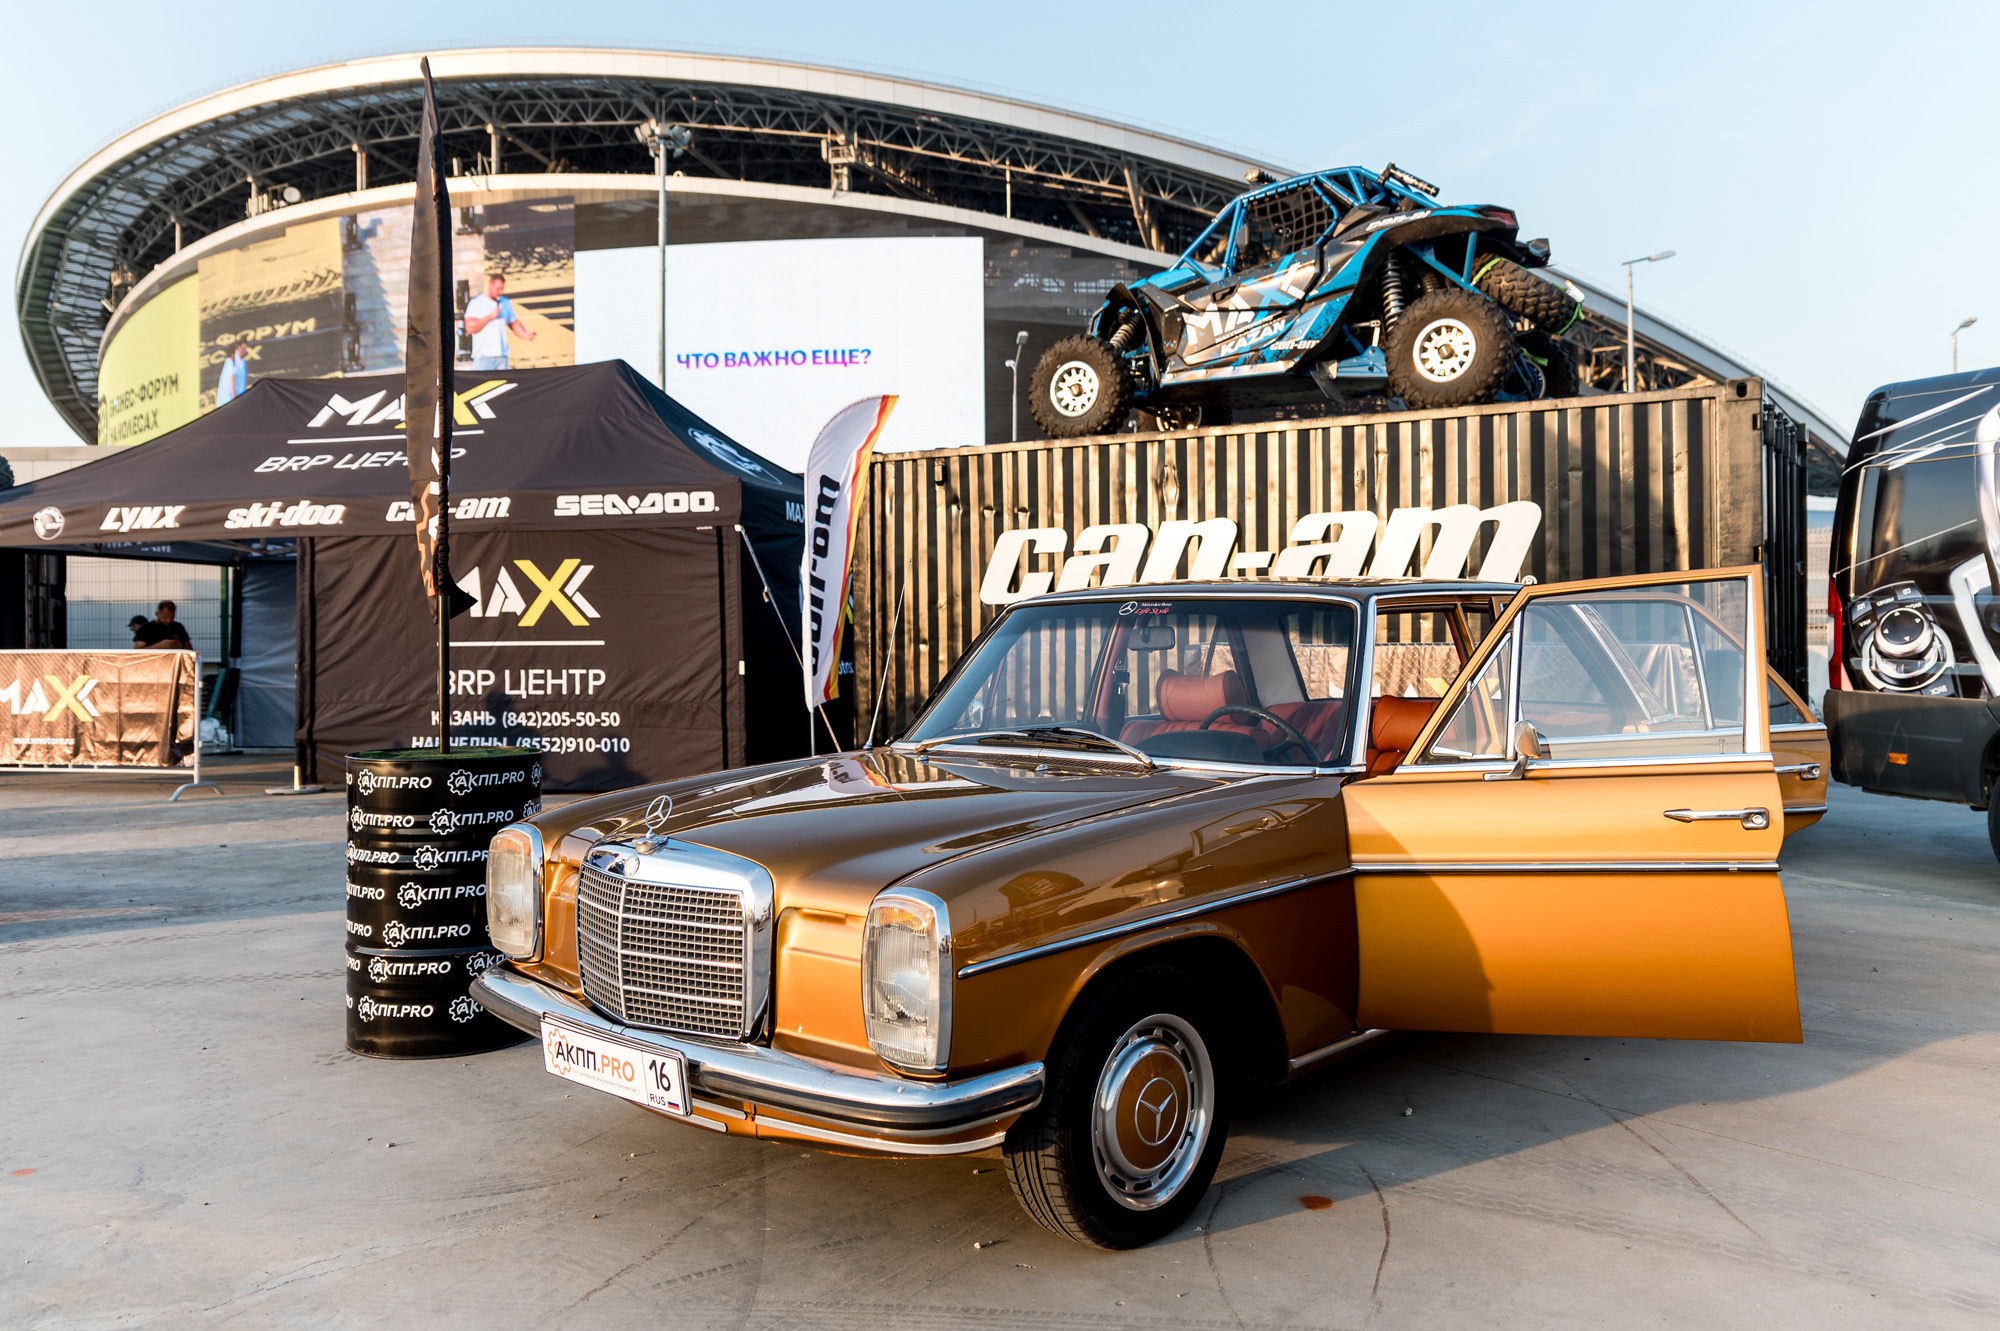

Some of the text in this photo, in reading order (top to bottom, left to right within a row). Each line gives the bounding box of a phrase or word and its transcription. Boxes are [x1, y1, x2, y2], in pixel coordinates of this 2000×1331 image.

[676, 349, 872, 369] ЧТО ВАЖНО ЕЩЕ?
[254, 454, 334, 472] BRP
[99, 505, 186, 532] LYNX
[223, 500, 346, 529] ski-doo
[979, 500, 1542, 605] can-am
[504, 669, 606, 699] ЦЕНТР
[431, 711, 620, 729] КЗАНЬ (842)205-50-50
[516, 736, 630, 753] (8552)910-010
[649, 1059, 671, 1092] 16
[650, 1093, 666, 1107] RUS
